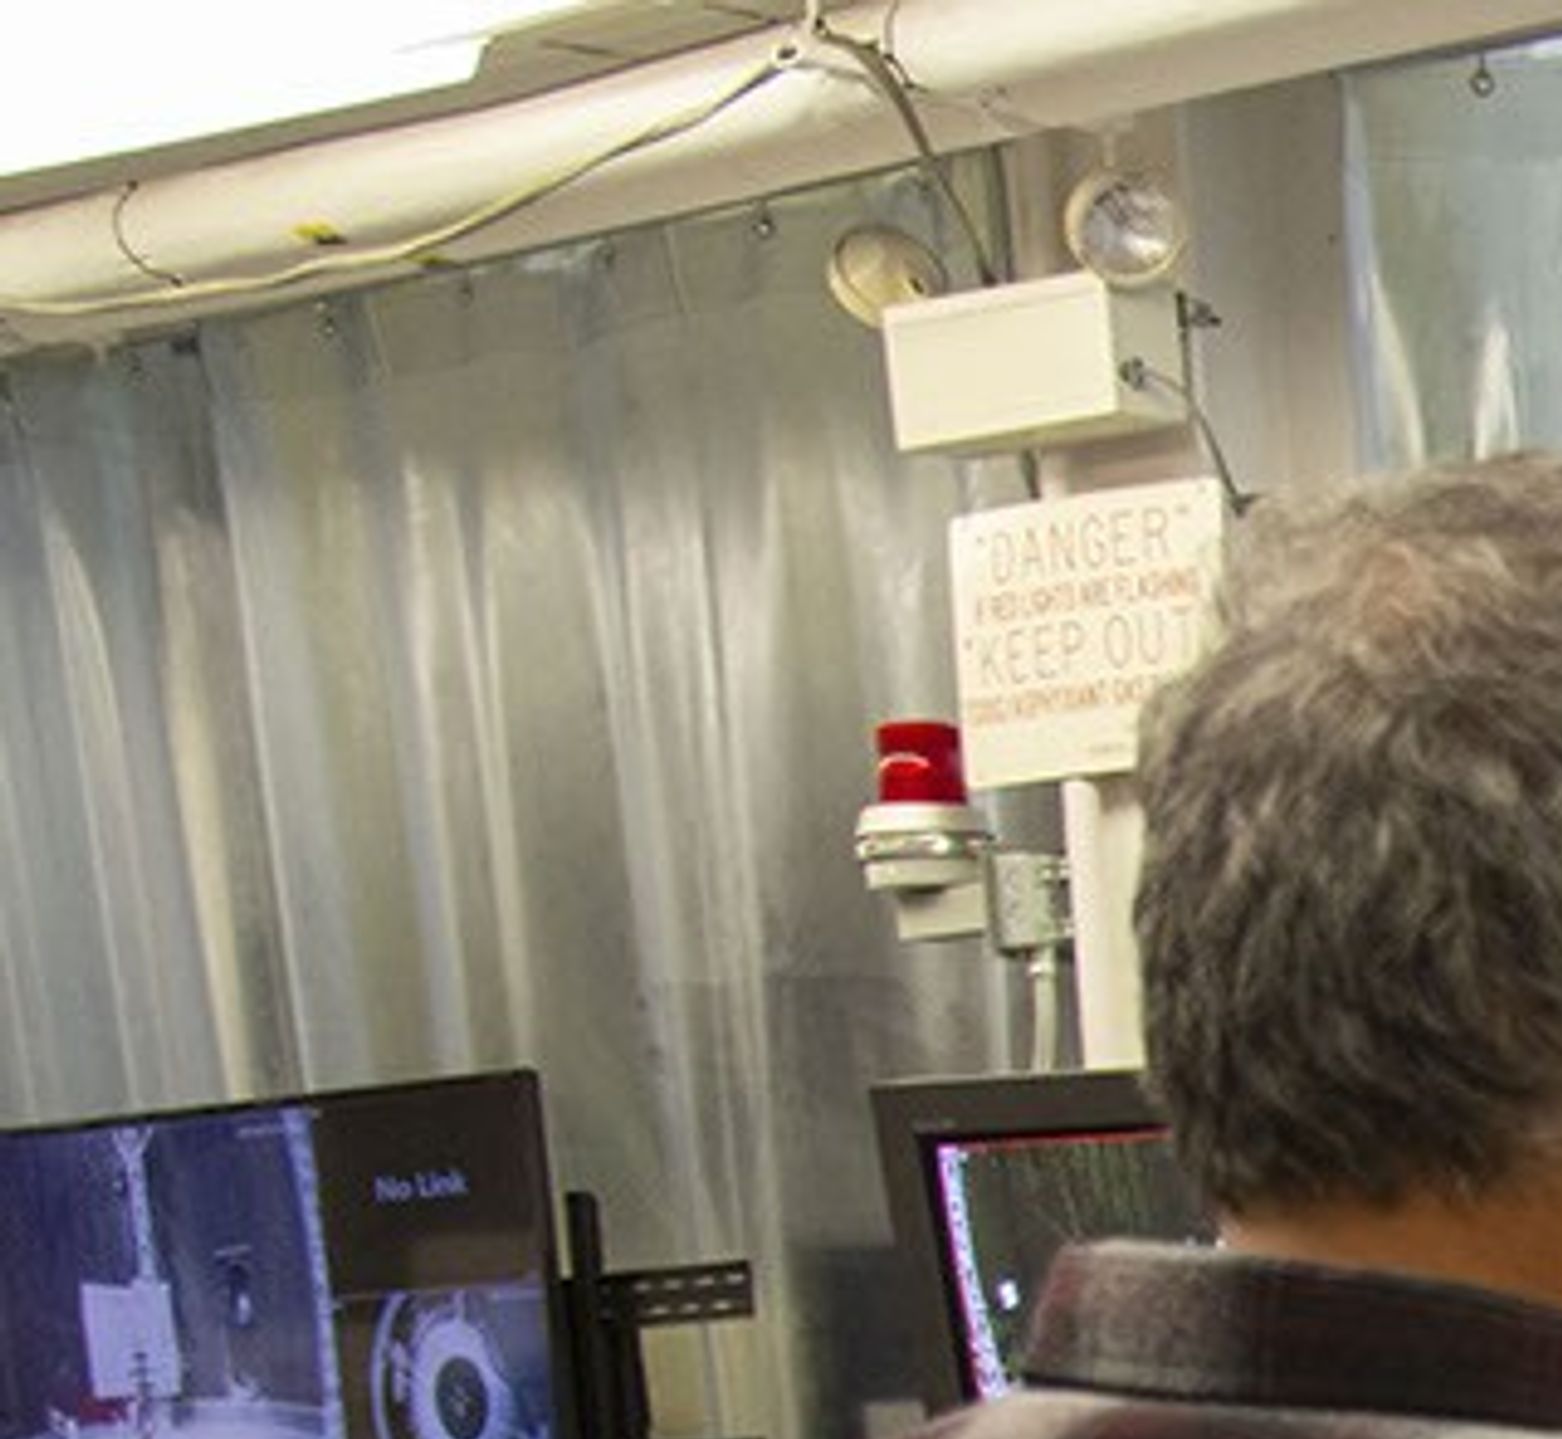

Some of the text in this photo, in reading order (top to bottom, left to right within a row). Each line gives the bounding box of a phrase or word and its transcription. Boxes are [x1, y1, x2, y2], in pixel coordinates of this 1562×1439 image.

[990, 507, 1170, 584] DANGER
[979, 604, 1193, 685] KEEP OUT
[375, 1169, 470, 1202] No Link
